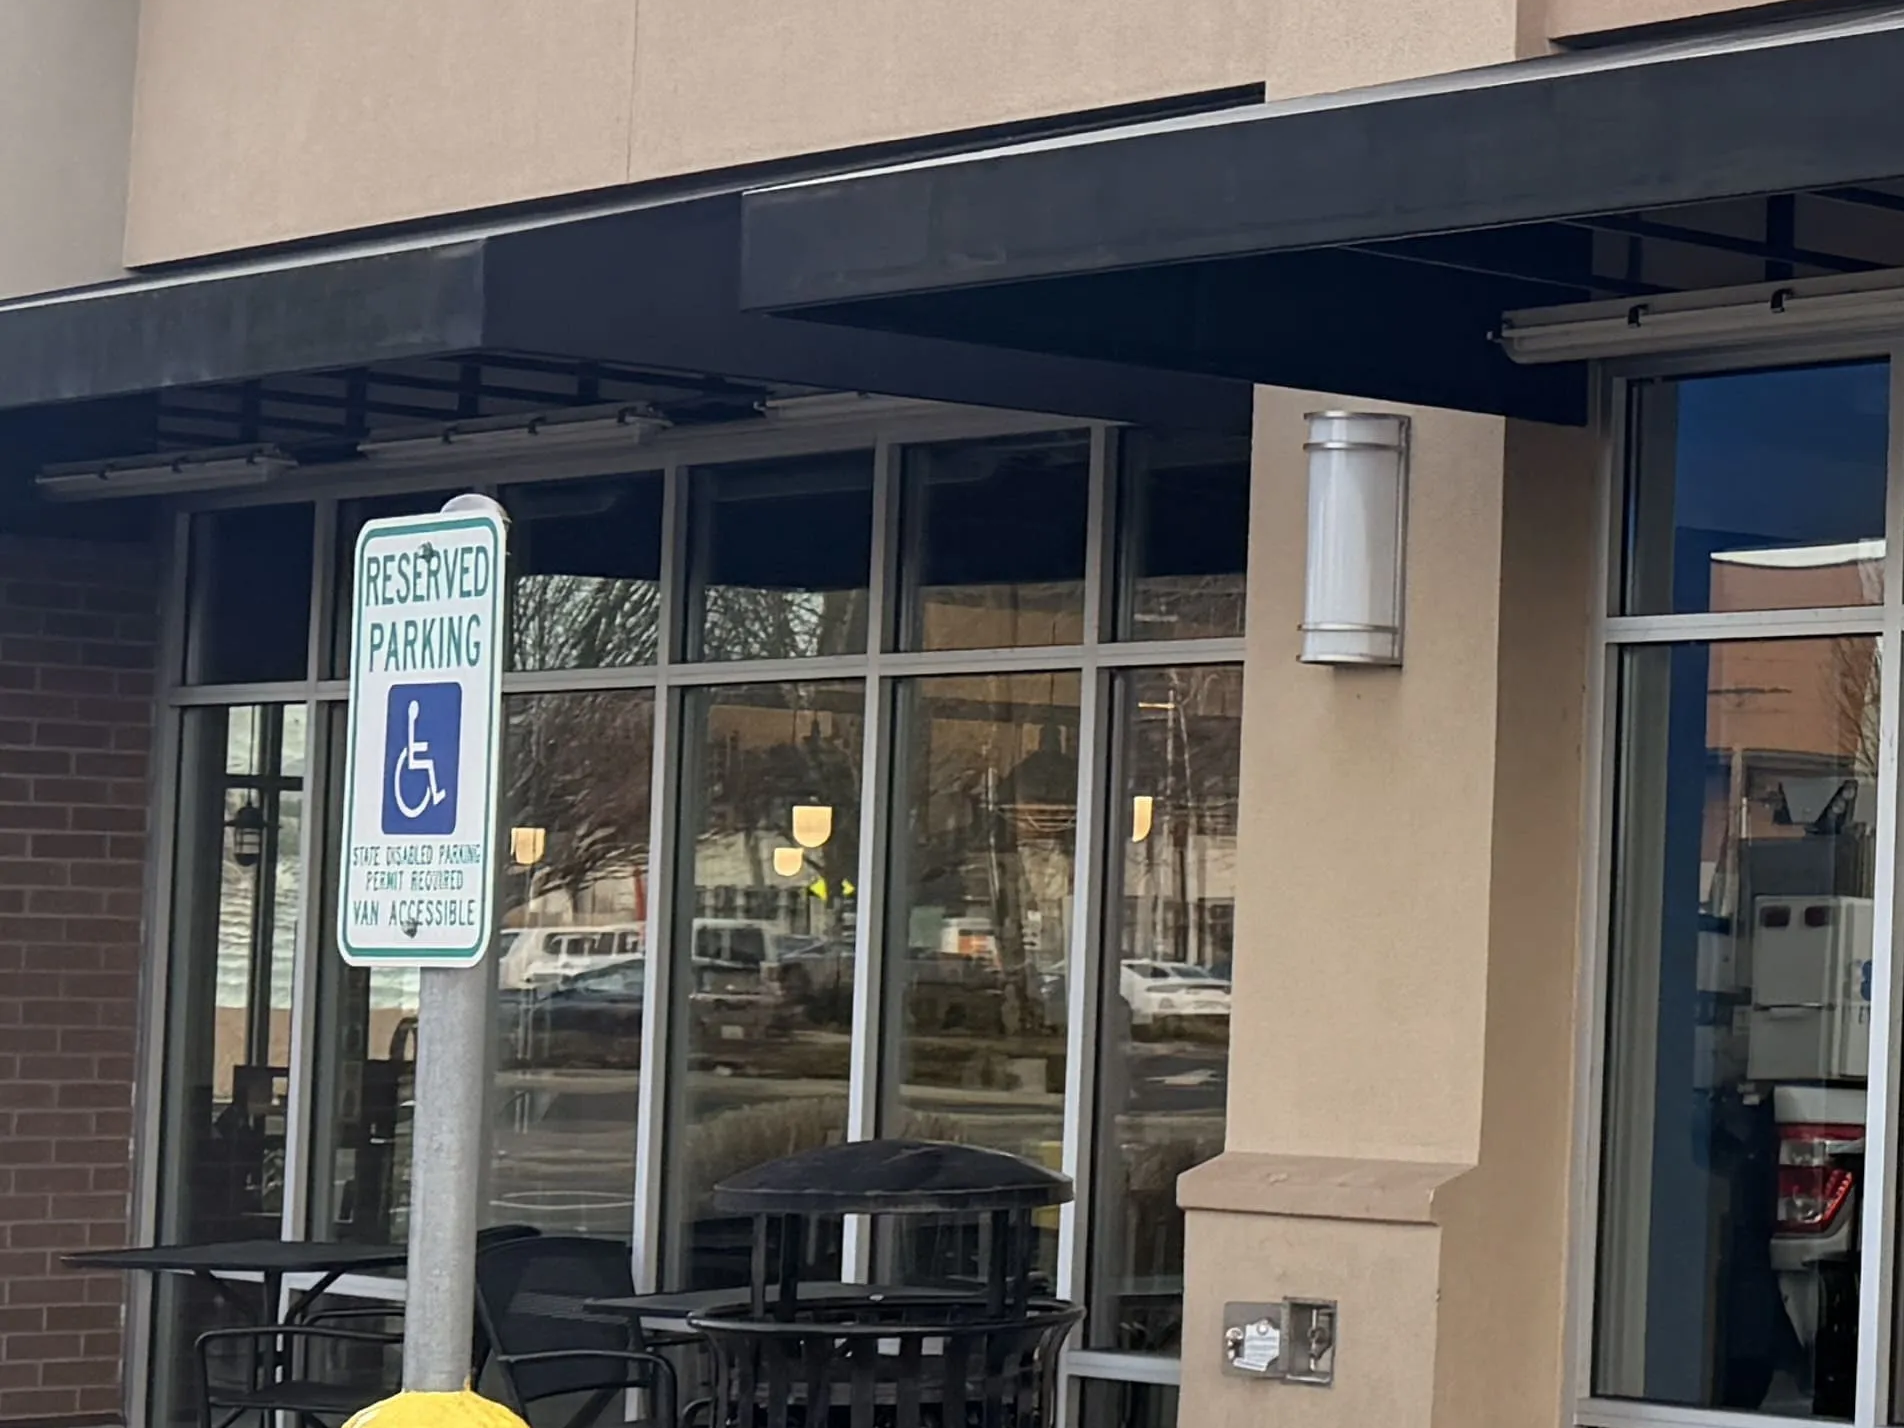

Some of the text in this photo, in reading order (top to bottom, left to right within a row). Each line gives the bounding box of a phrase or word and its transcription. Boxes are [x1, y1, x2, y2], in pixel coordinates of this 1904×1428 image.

[365, 544, 489, 607] RESERVED
[369, 613, 481, 672] PARKING
[353, 843, 481, 866] STATE DISABLED PARKING
[366, 869, 463, 891] PERMIT REQUIRED
[353, 899, 476, 926] VAN ACCESSIBLE
